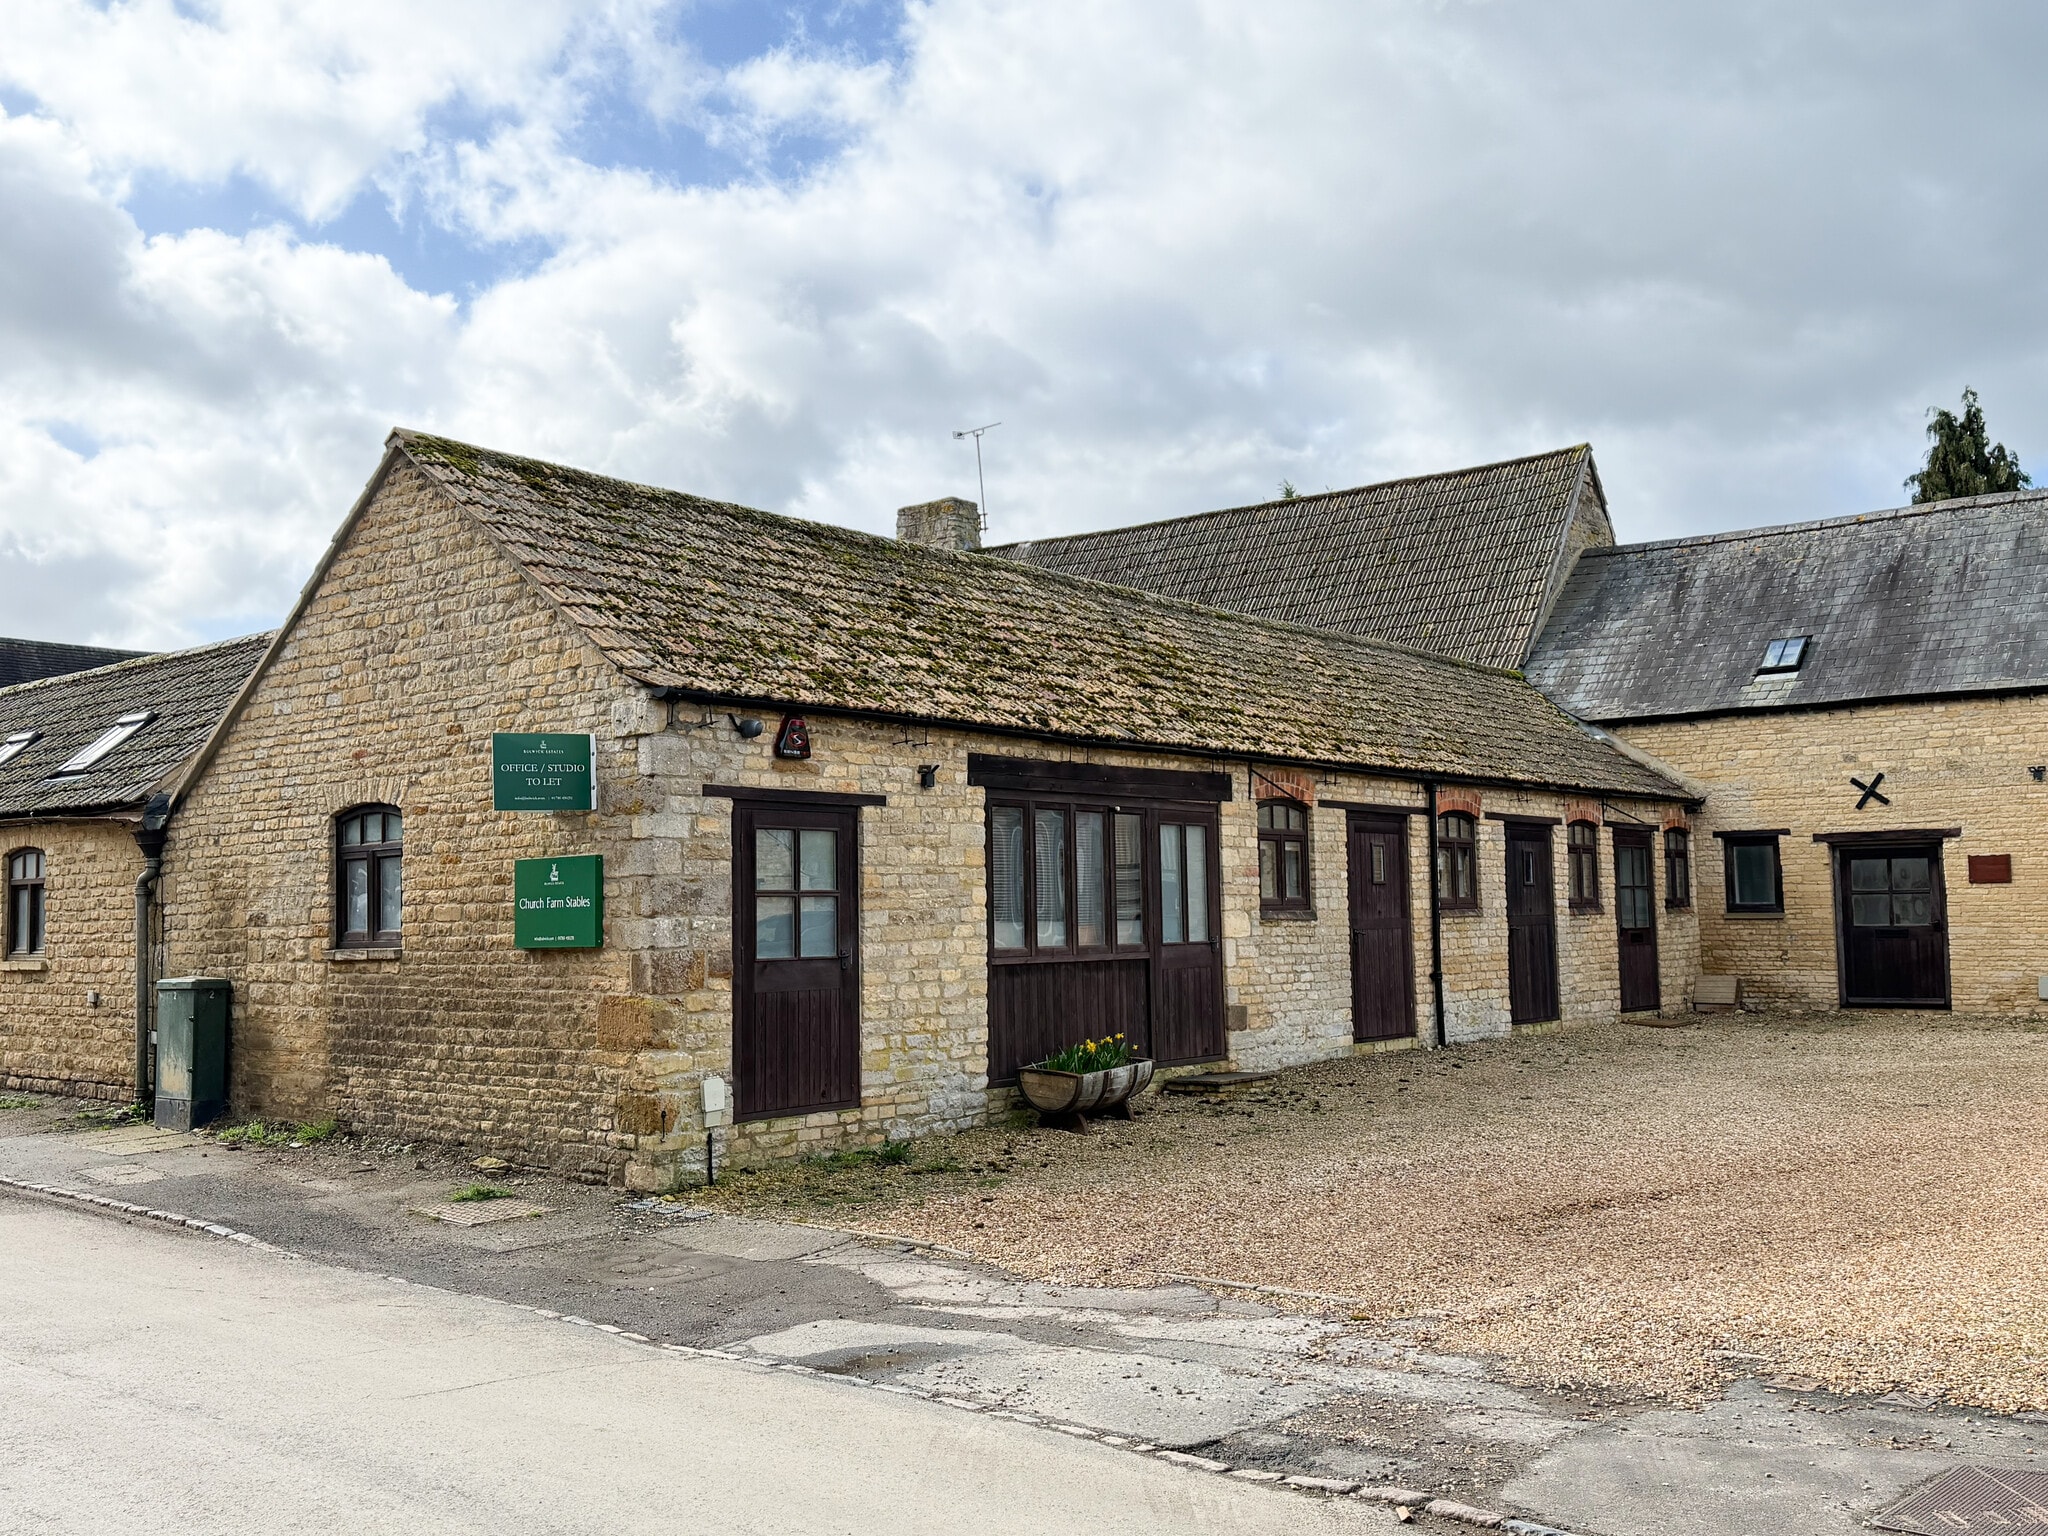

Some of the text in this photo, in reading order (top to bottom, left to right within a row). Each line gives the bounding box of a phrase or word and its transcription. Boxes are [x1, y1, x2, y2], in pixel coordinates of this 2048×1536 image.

[500, 763, 585, 773] OFFICE / STUDIO
[525, 777, 562, 786] TO LET
[519, 895, 590, 909] Church Farm Stables
